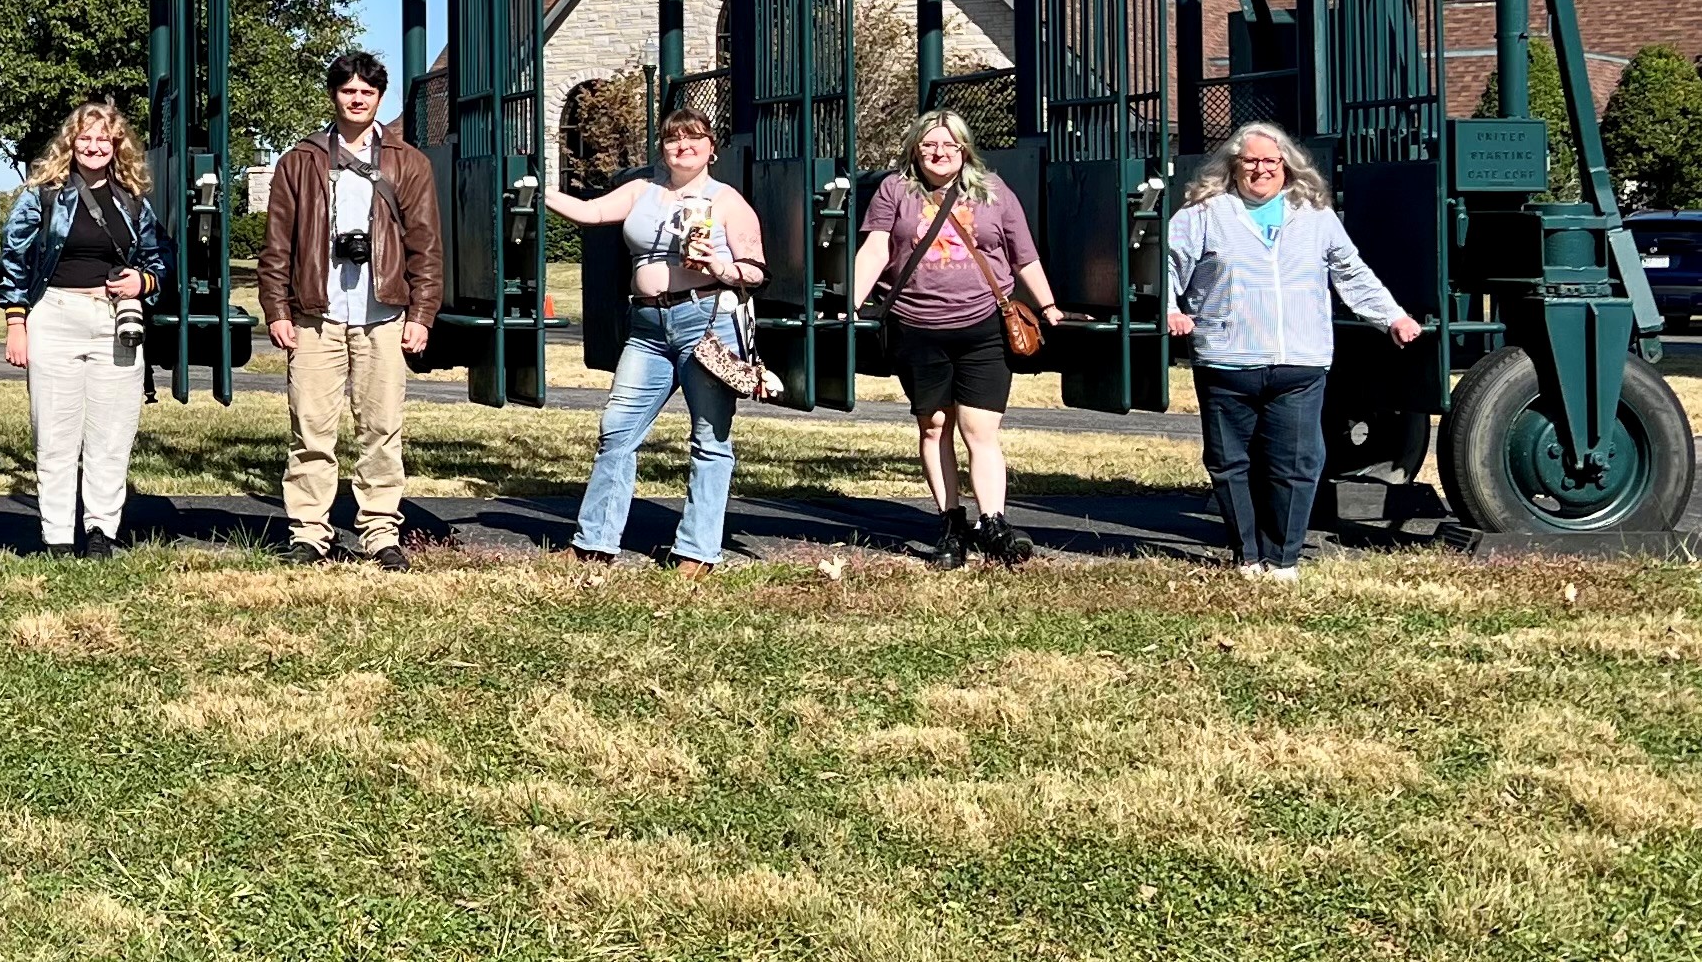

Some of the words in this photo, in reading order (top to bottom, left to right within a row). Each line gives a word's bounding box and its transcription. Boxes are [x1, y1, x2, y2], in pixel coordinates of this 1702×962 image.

[1476, 131, 1526, 141] UNITED
[1470, 150, 1534, 160] STARTING
[1467, 169, 1499, 179] GATE
